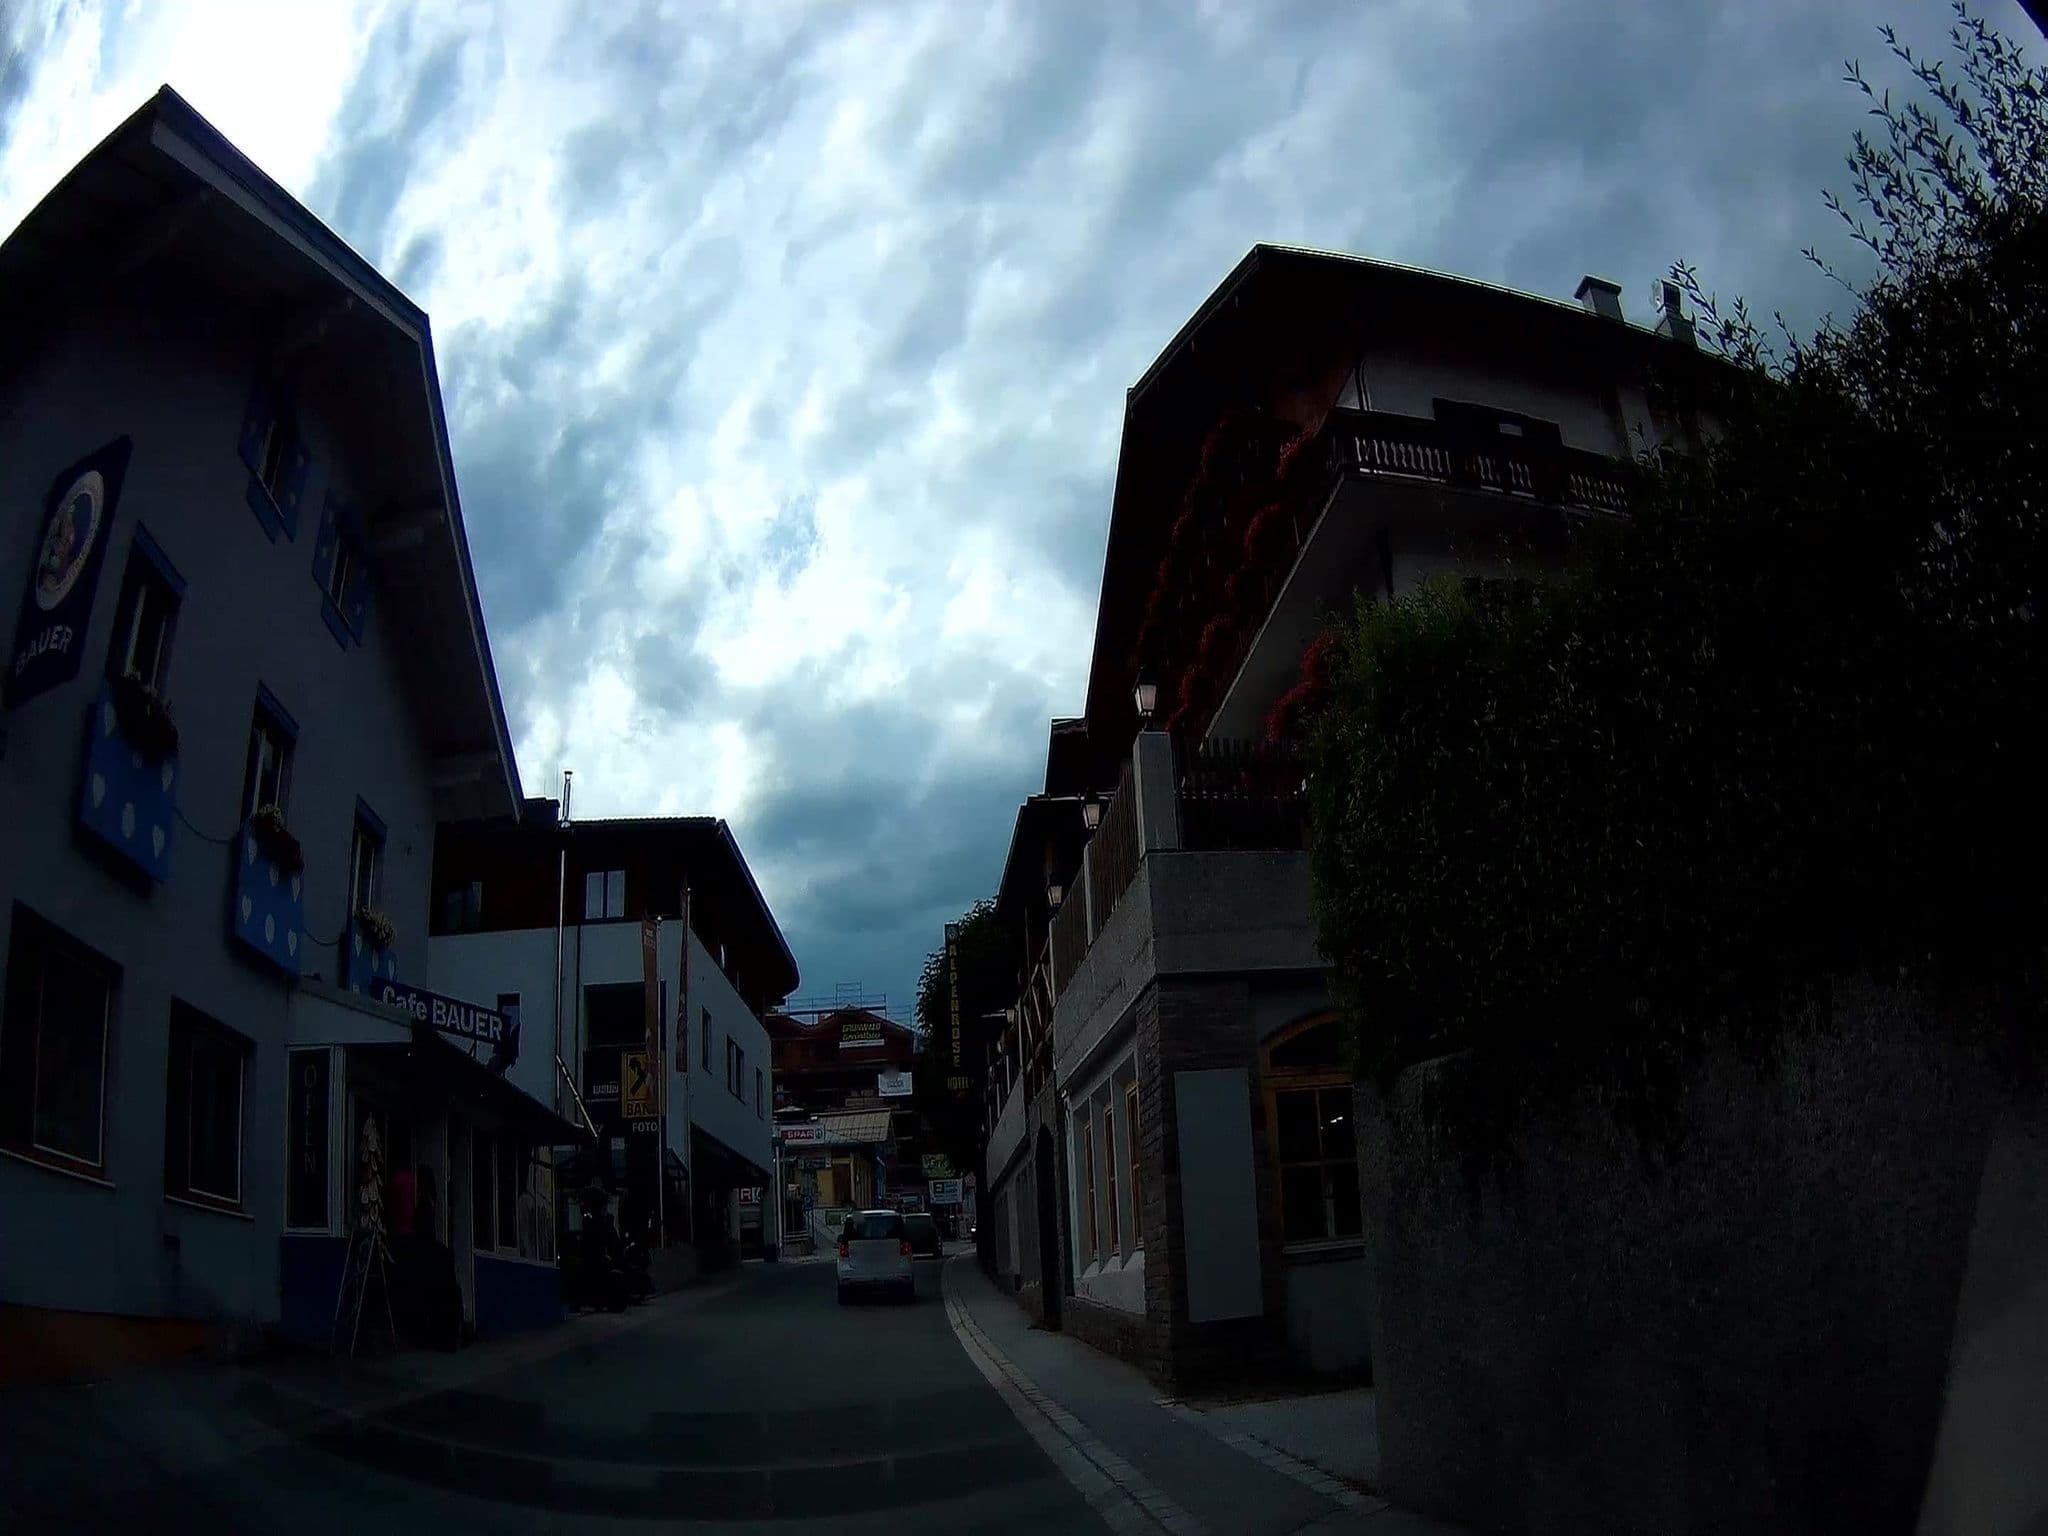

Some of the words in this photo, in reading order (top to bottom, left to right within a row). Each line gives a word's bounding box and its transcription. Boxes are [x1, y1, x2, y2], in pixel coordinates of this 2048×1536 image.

[15, 623, 73, 680] BAUER
[382, 985, 428, 1022] Cafe
[431, 998, 503, 1041] BAUER
[632, 1121, 659, 1133] FOTO
[787, 1129, 814, 1140] SPAR
